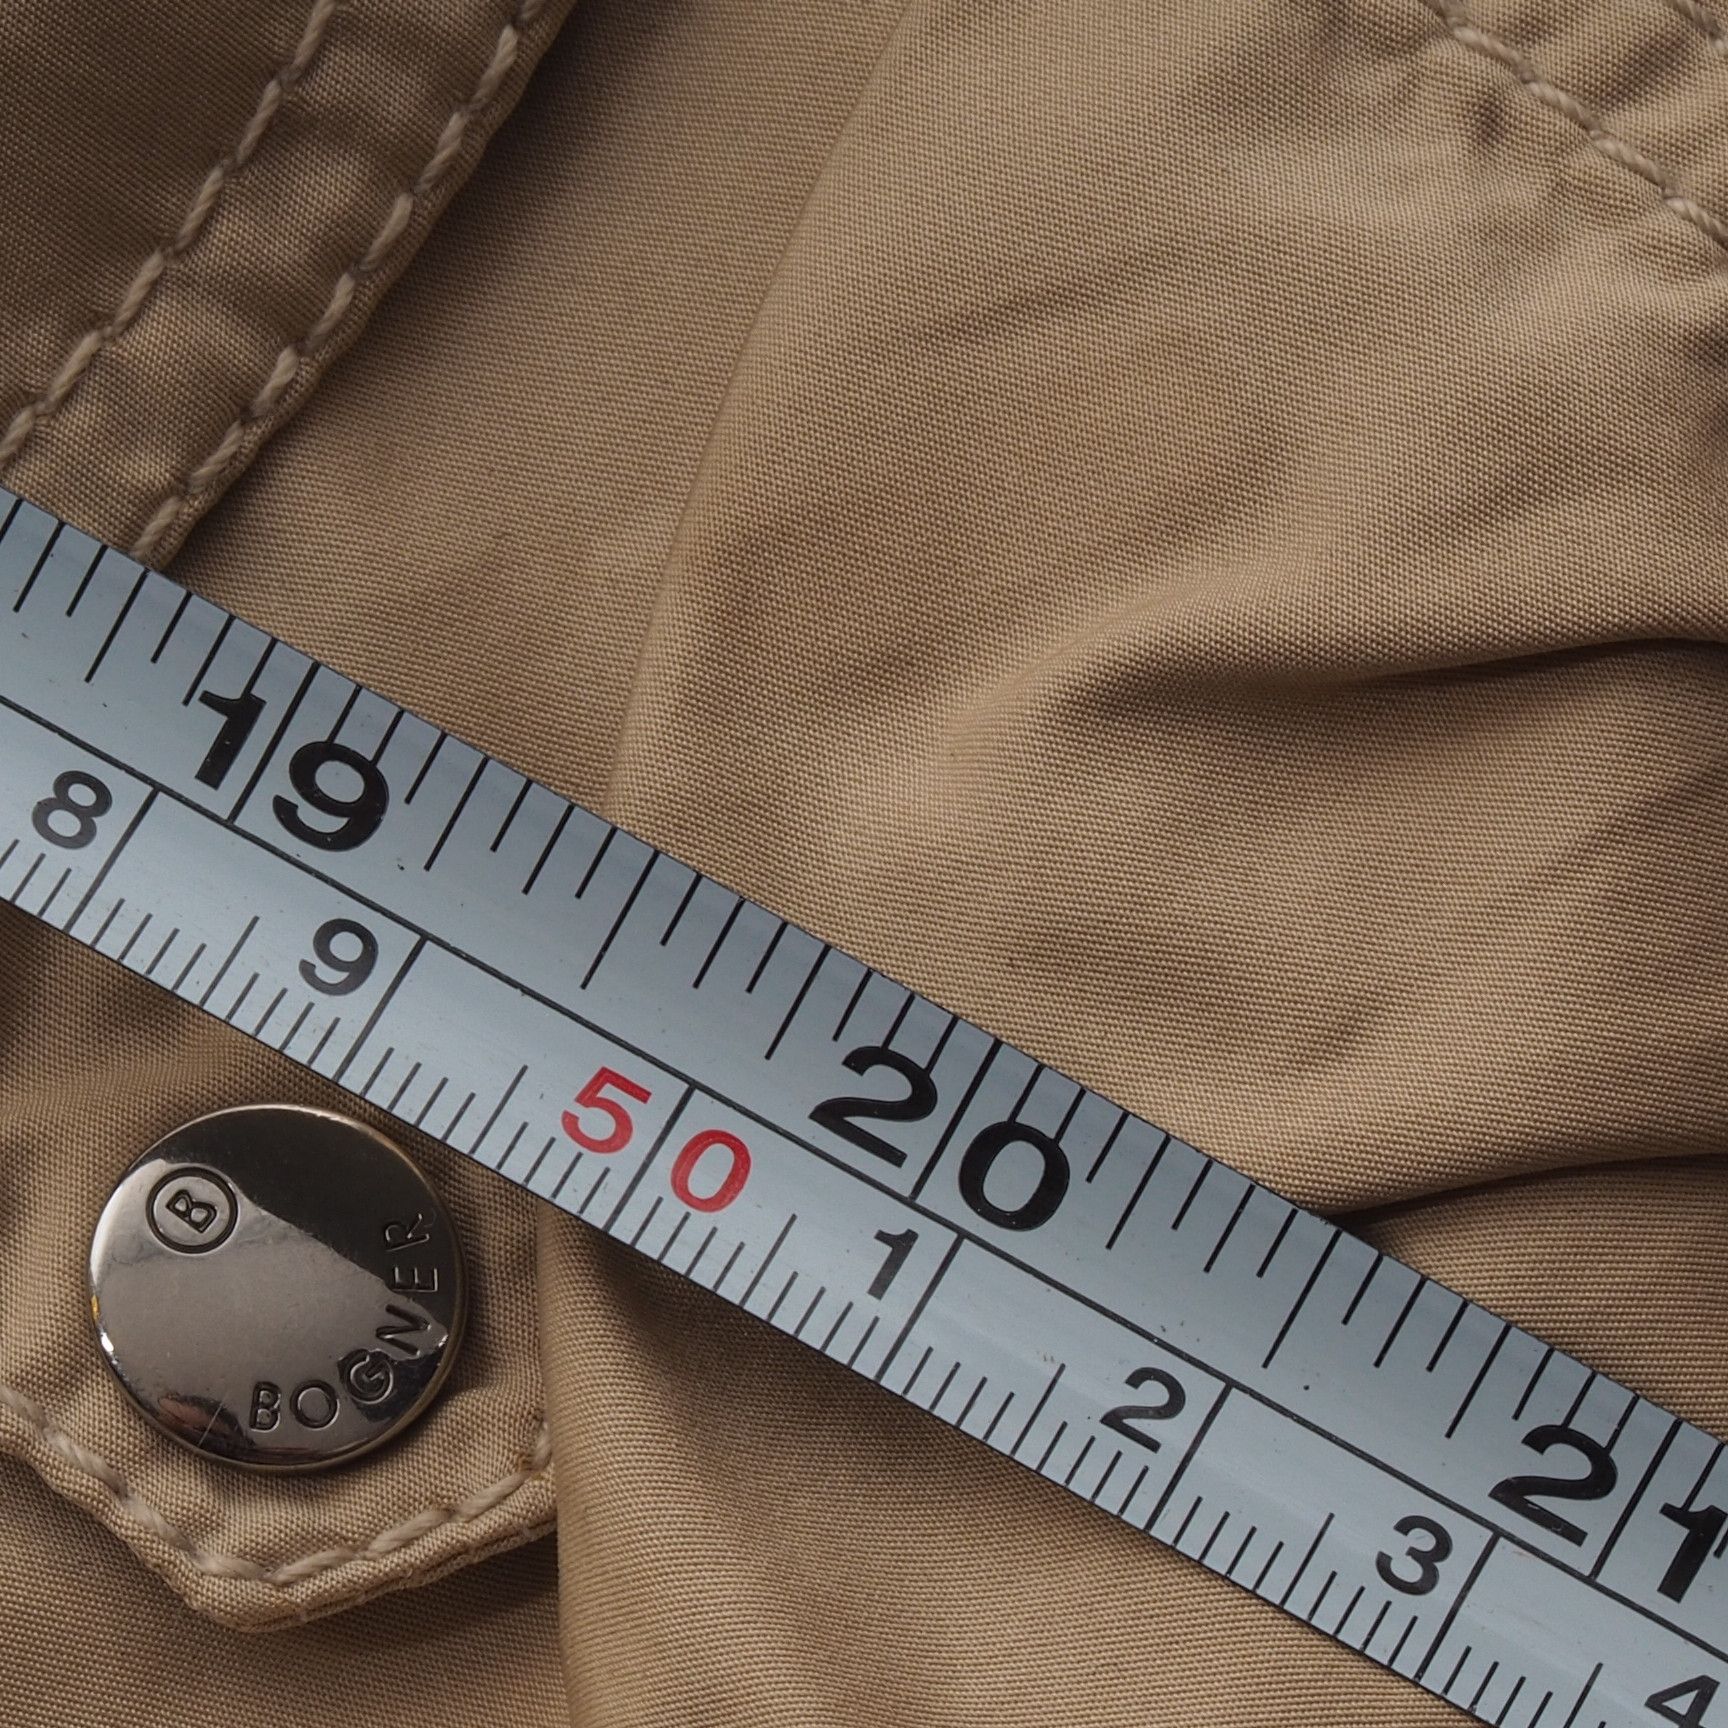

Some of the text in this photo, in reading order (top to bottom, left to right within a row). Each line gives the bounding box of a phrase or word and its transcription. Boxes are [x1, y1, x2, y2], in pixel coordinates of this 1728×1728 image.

[32, 771, 112, 848] 8
[298, 919, 378, 996] 9
[561, 1067, 752, 1213] 50
[869, 1228, 919, 1298] 1
[1099, 1366, 1185, 1452] 2
[1376, 1515, 1451, 1595] 3
[165, 1188, 218, 1234] B
[196, 690, 389, 851] 19
[809, 1046, 1070, 1231] 20
[1489, 1424, 1728, 1602] 21
[249, 1211, 440, 1432] BOGNER
